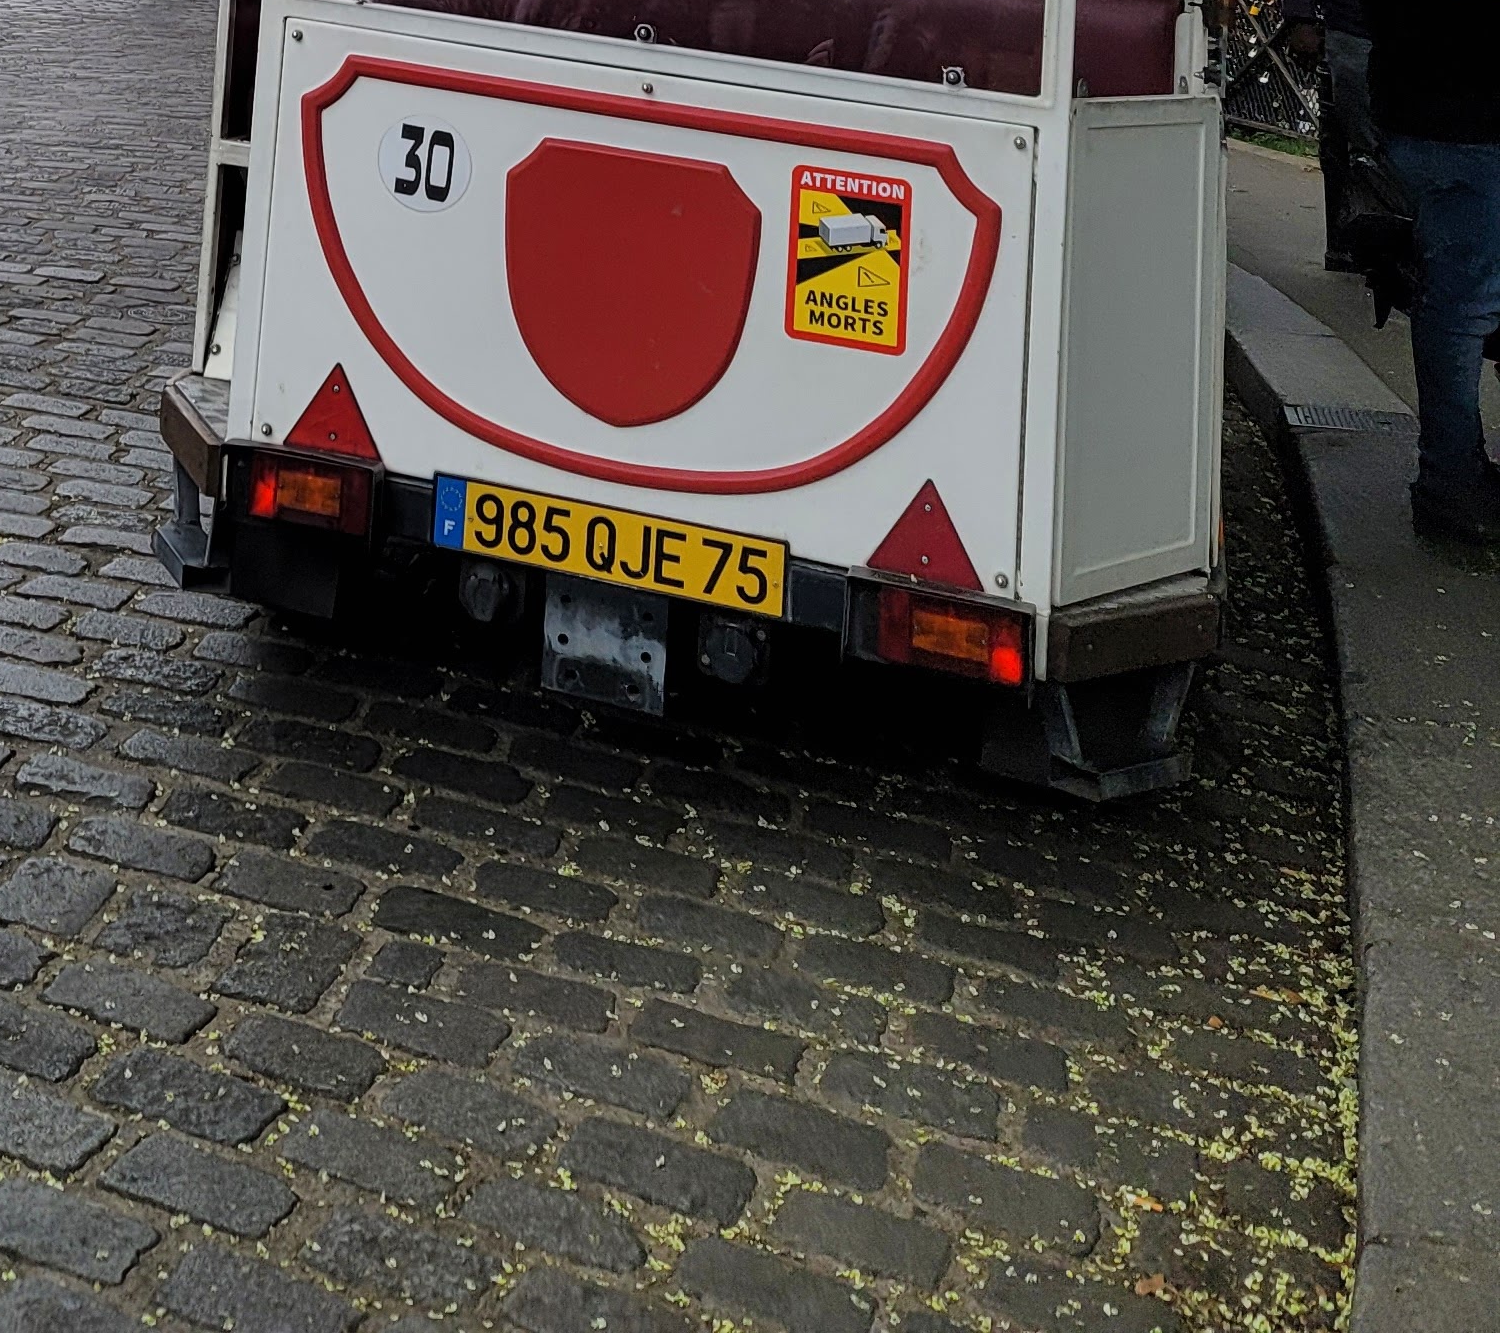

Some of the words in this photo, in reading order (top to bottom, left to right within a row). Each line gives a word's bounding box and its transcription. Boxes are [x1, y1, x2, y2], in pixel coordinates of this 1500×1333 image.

[393, 122, 455, 203] 30
[800, 170, 905, 200] ATTENTION
[804, 289, 889, 318] ANGLES
[808, 309, 885, 337] MORTS
[443, 519, 456, 537] F
[473, 493, 572, 563] 985
[585, 515, 688, 590] QJE
[701, 537, 769, 605] 75
